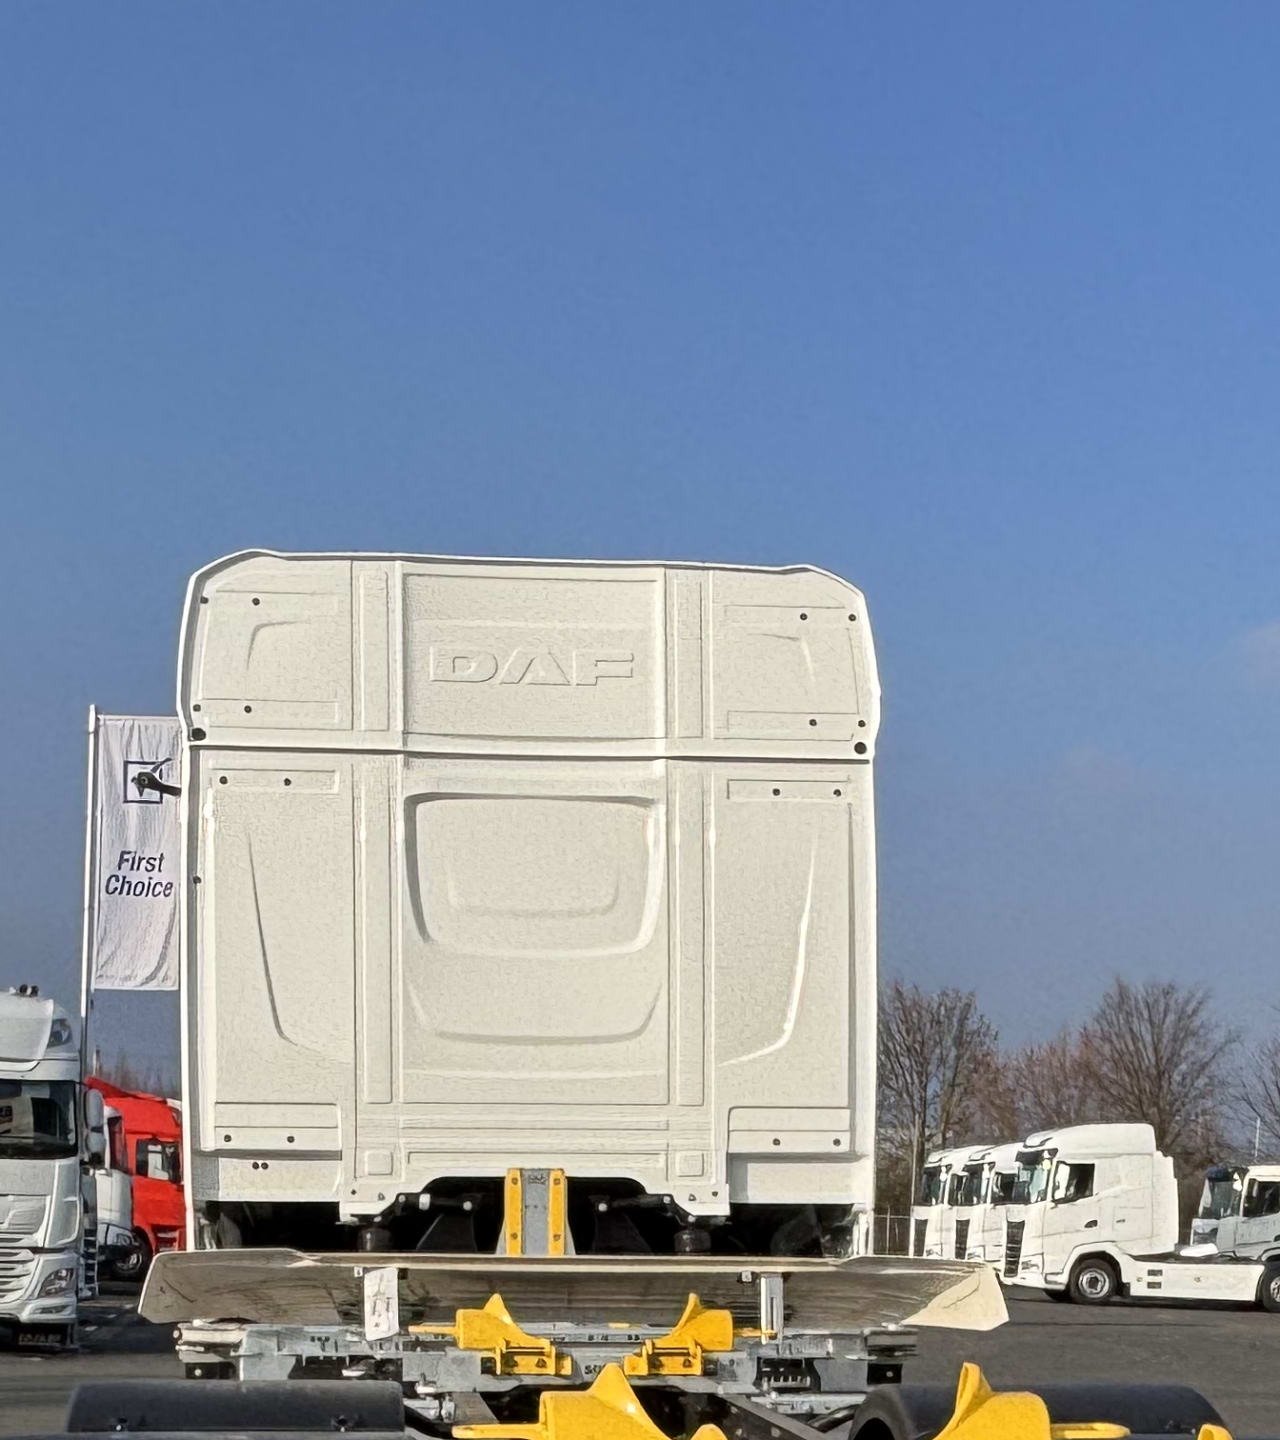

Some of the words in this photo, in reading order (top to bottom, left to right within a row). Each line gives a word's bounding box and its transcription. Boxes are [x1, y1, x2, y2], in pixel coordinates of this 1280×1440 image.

[429, 647, 634, 686] DAF
[117, 851, 165, 873] First
[105, 874, 174, 898] Choice
